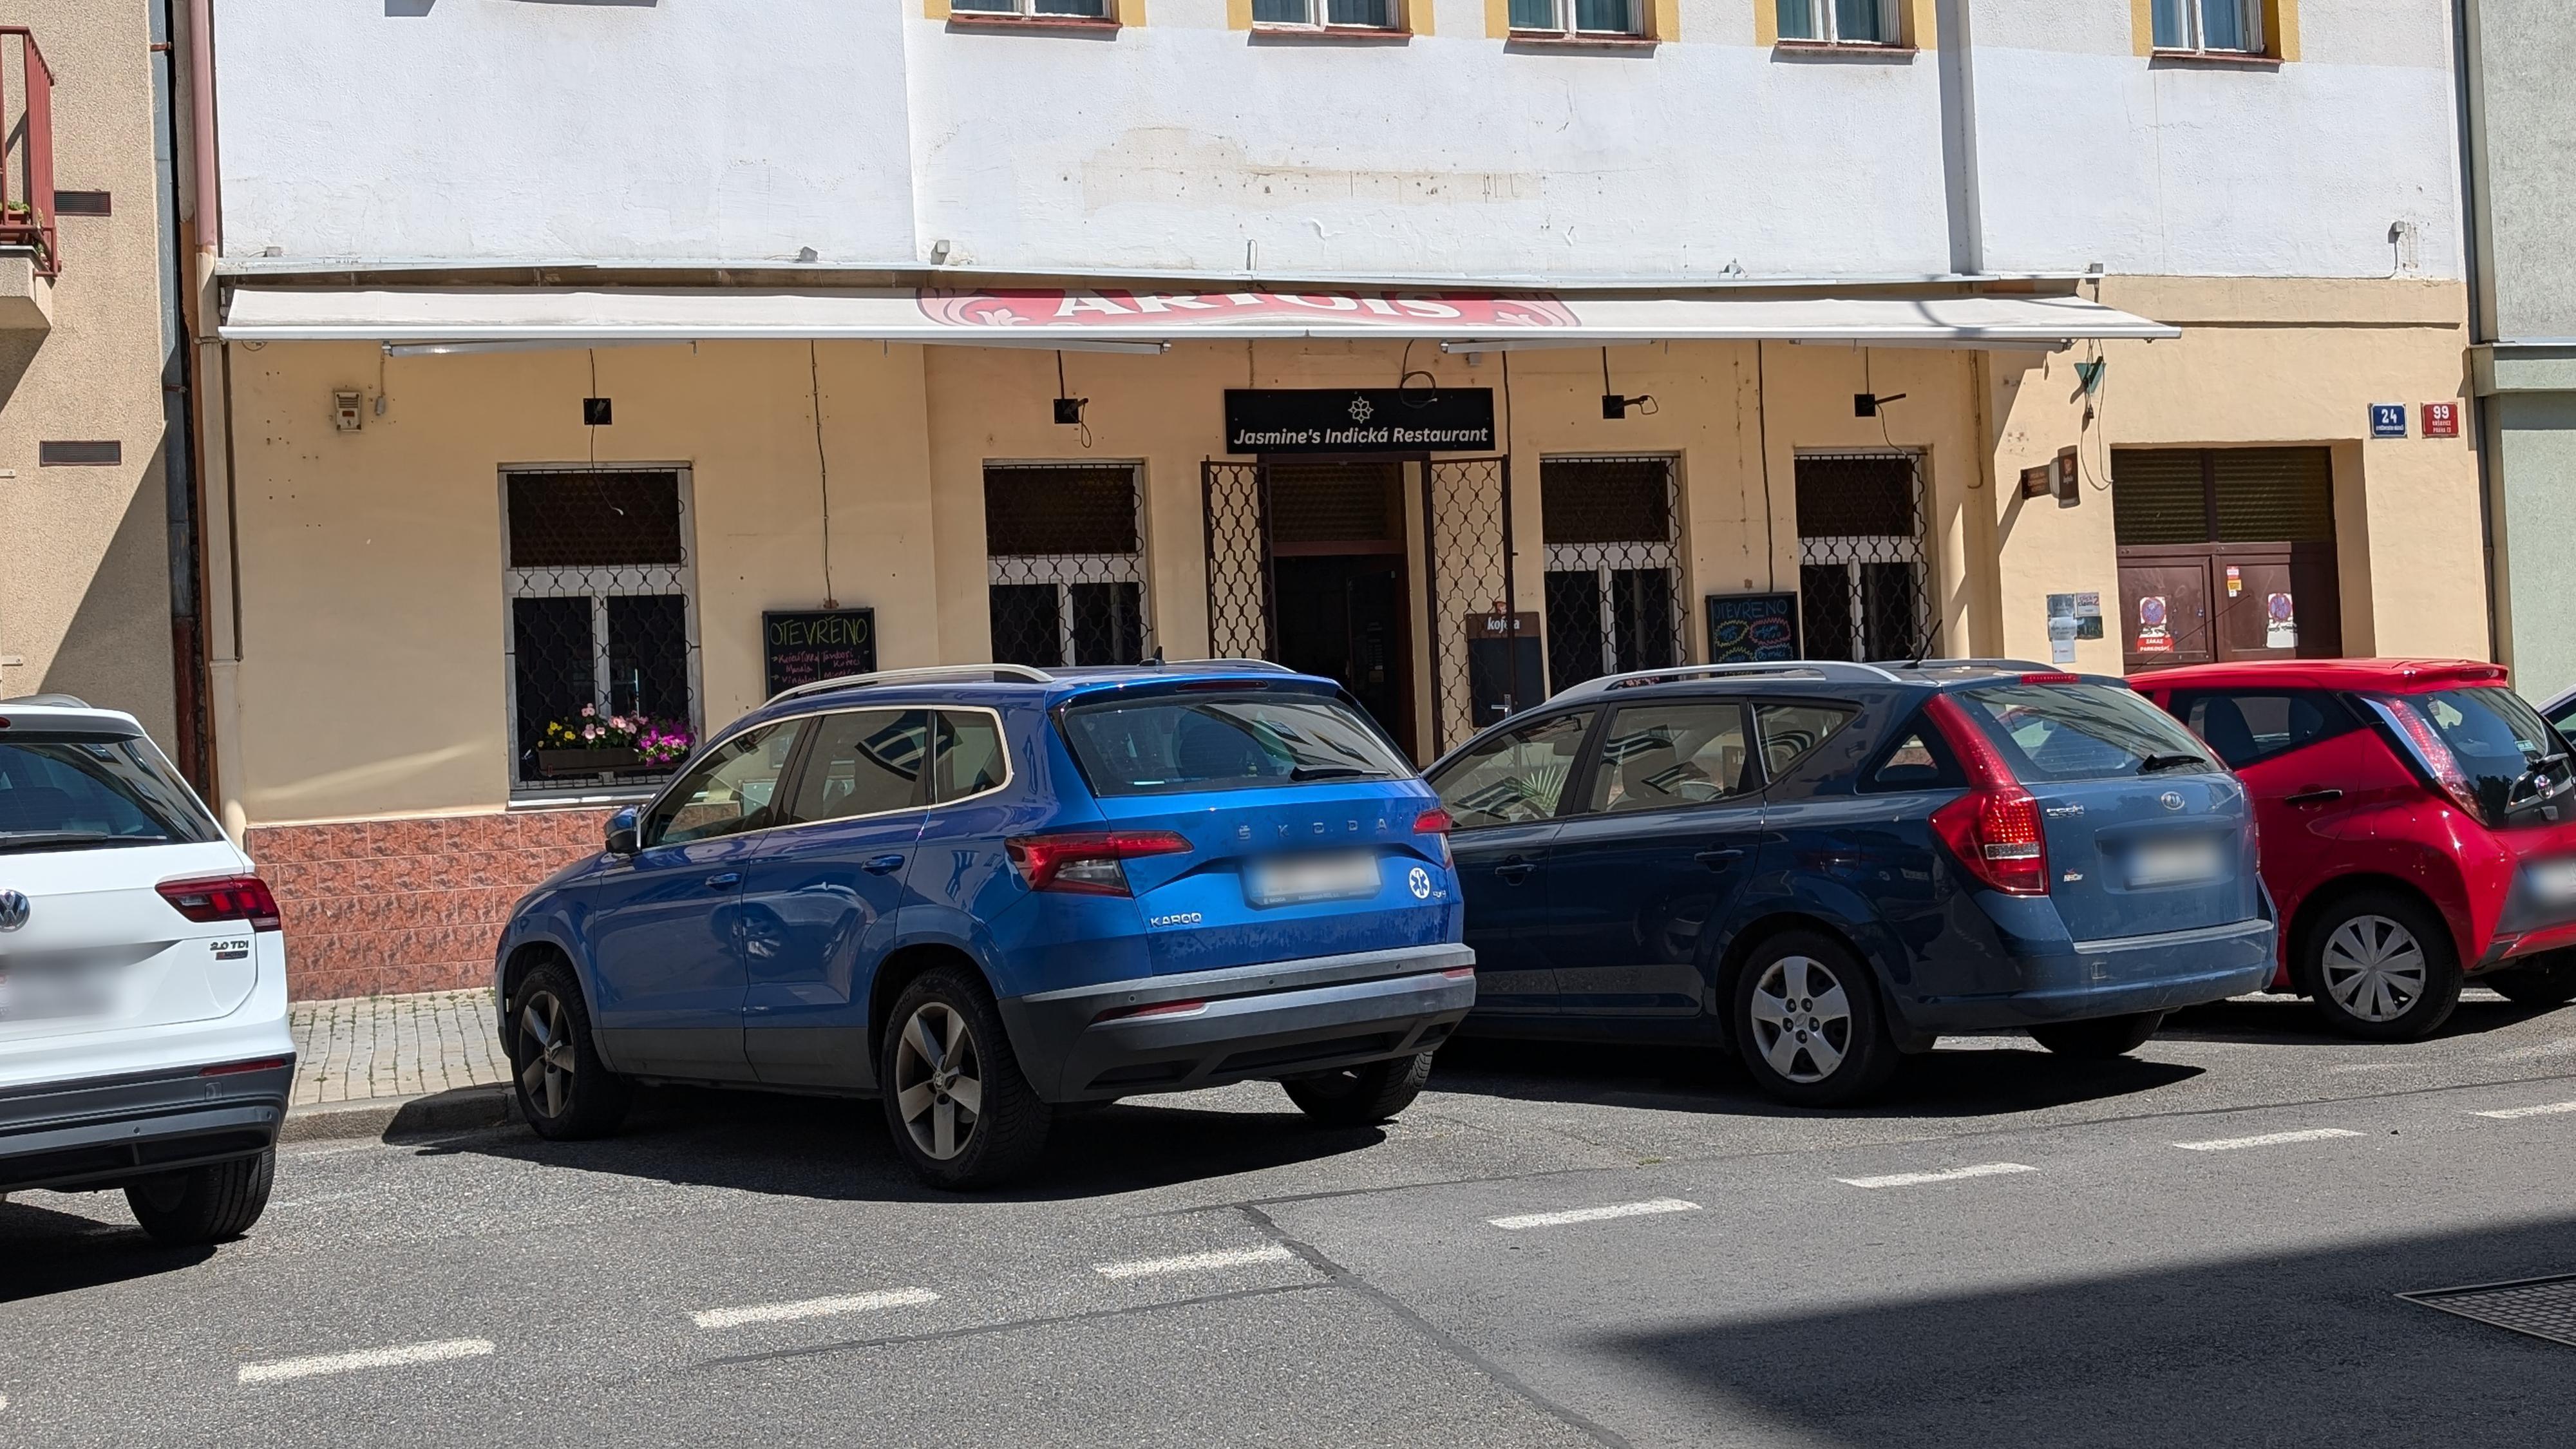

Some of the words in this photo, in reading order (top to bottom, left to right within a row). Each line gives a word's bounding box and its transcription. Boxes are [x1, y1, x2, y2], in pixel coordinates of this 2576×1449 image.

[2381, 408, 2397, 424] 24
[2433, 406, 2449, 419] 99
[1234, 429, 1321, 444] Jasmine's
[1325, 427, 1388, 443] Indická
[1393, 428, 1488, 442] Restaurant
[770, 615, 867, 646] OTEVŘENO
[1150, 912, 1202, 927] KAROQ
[210, 942, 229, 951] 2.0
[231, 940, 249, 949] TDI
